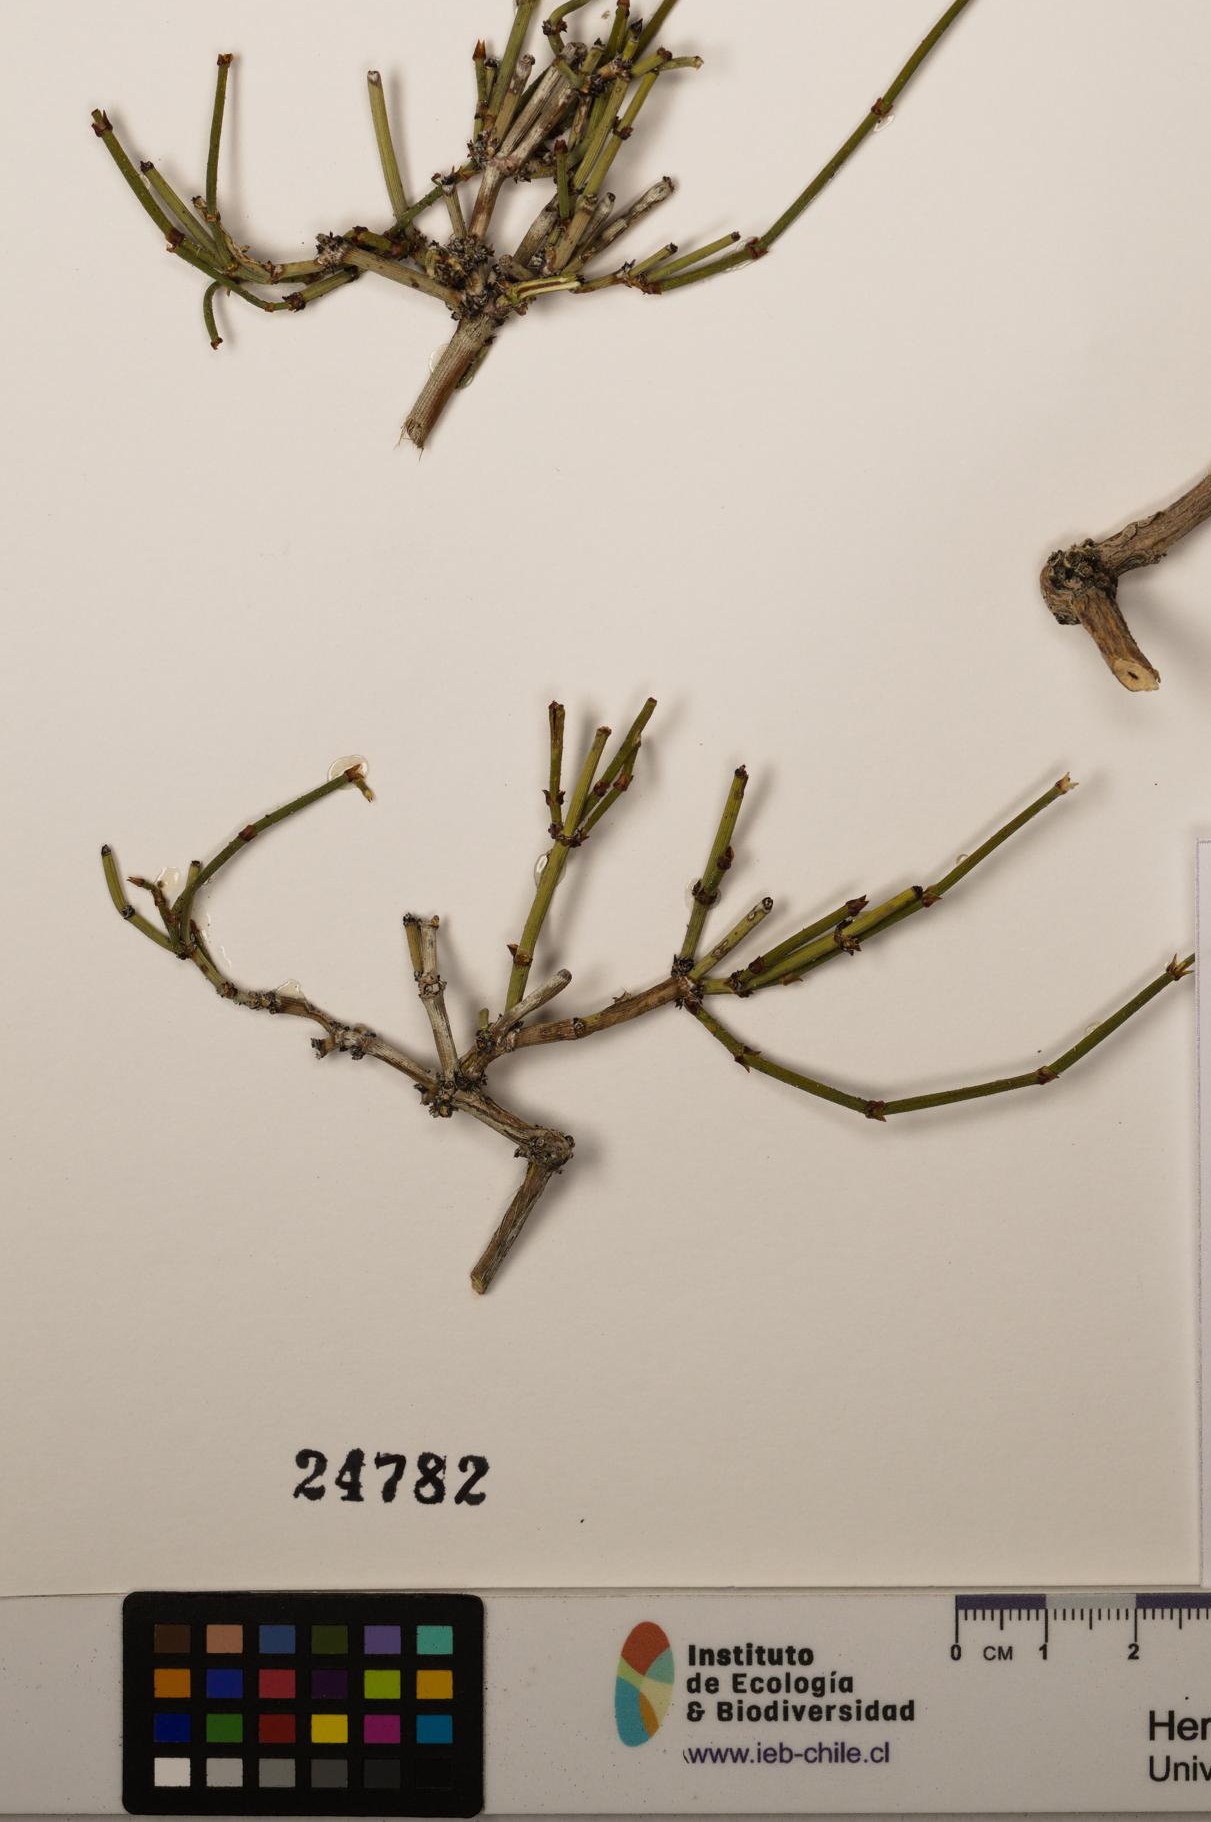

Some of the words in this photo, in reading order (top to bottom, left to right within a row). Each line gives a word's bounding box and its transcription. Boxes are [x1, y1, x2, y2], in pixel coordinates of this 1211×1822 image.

[292, 1447, 490, 1507] 24782
[688, 1642, 815, 1667] Instituto
[950, 1644, 962, 1660] 0
[983, 1646, 1013, 1660] CM
[1038, 1644, 1048, 1660] 1
[1128, 1643, 1140, 1660] 2
[686, 1671, 720, 1695] de
[731, 1670, 854, 1699] Ecología
[686, 1700, 706, 1723] &
[716, 1698, 915, 1723] Biodiversidad
[687, 1741, 890, 1764] www.ieb-chile.cl
